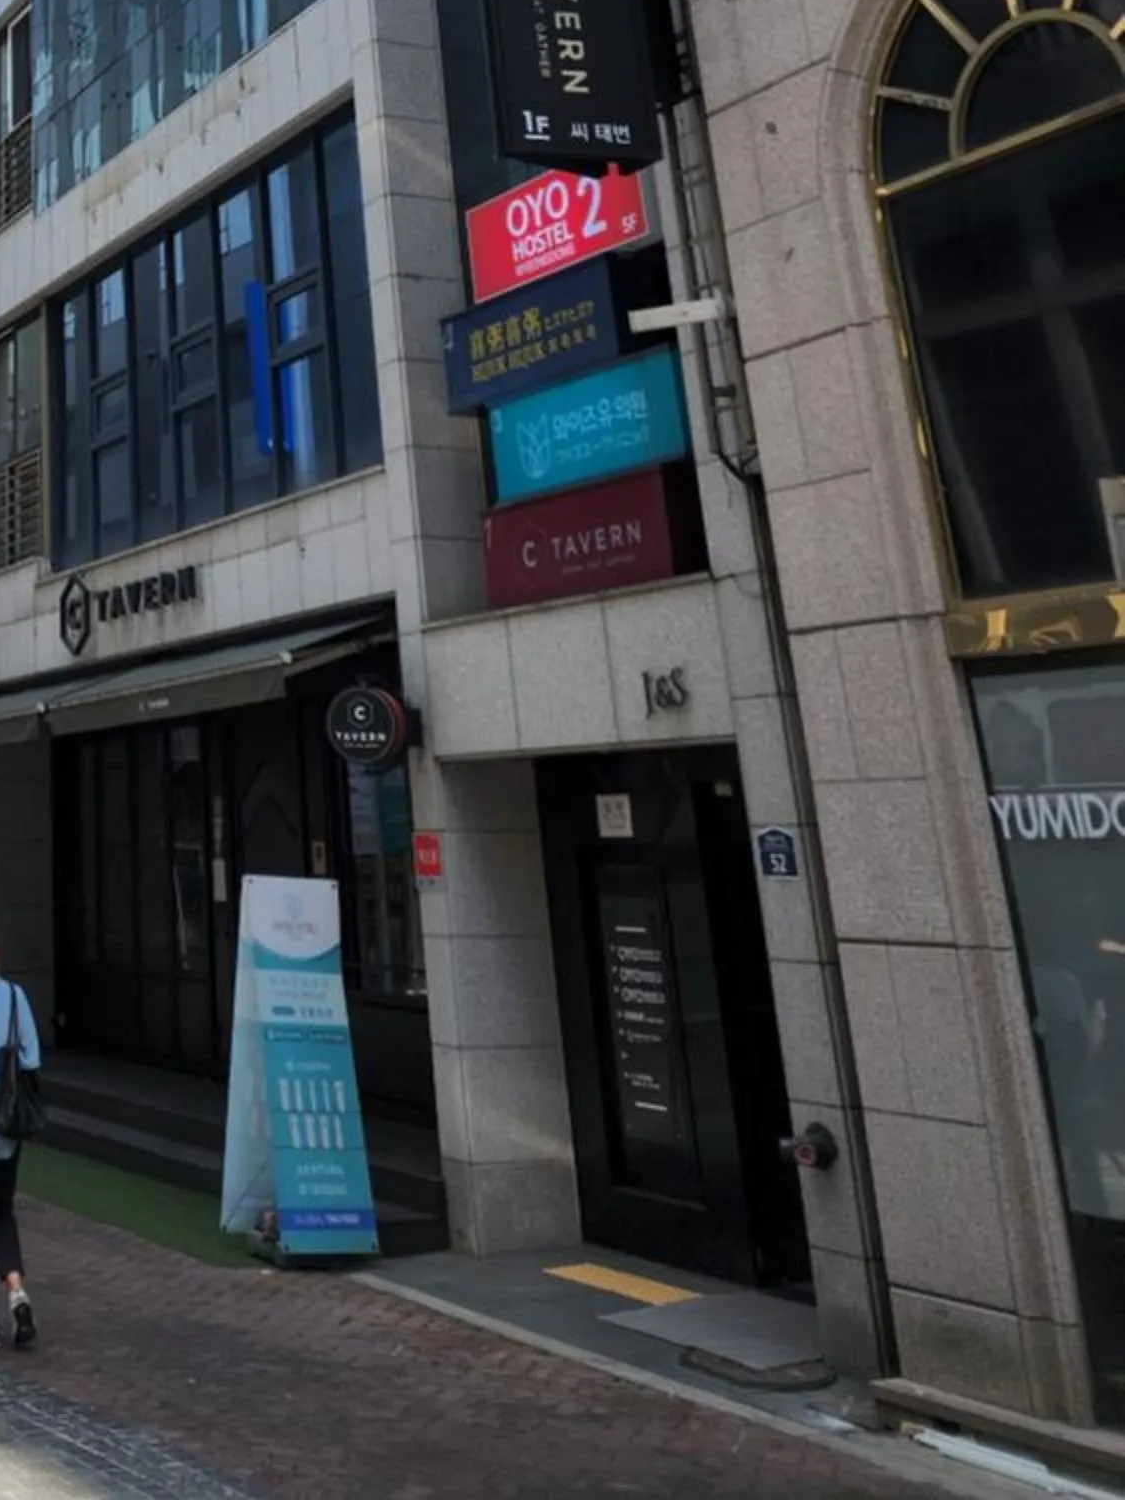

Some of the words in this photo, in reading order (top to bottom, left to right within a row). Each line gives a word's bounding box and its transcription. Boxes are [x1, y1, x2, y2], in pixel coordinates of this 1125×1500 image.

[522, 109, 551, 136] 1F
[506, 179, 569, 238] OYO
[576, 176, 608, 239] 2
[510, 219, 575, 262] HOSTEL
[551, 388, 649, 440] 와이즈유의원
[522, 541, 539, 568] C
[551, 520, 643, 561] TAVERN
[93, 565, 198, 623] TAVERN
[354, 705, 368, 721] C
[335, 731, 386, 742] TAVERN
